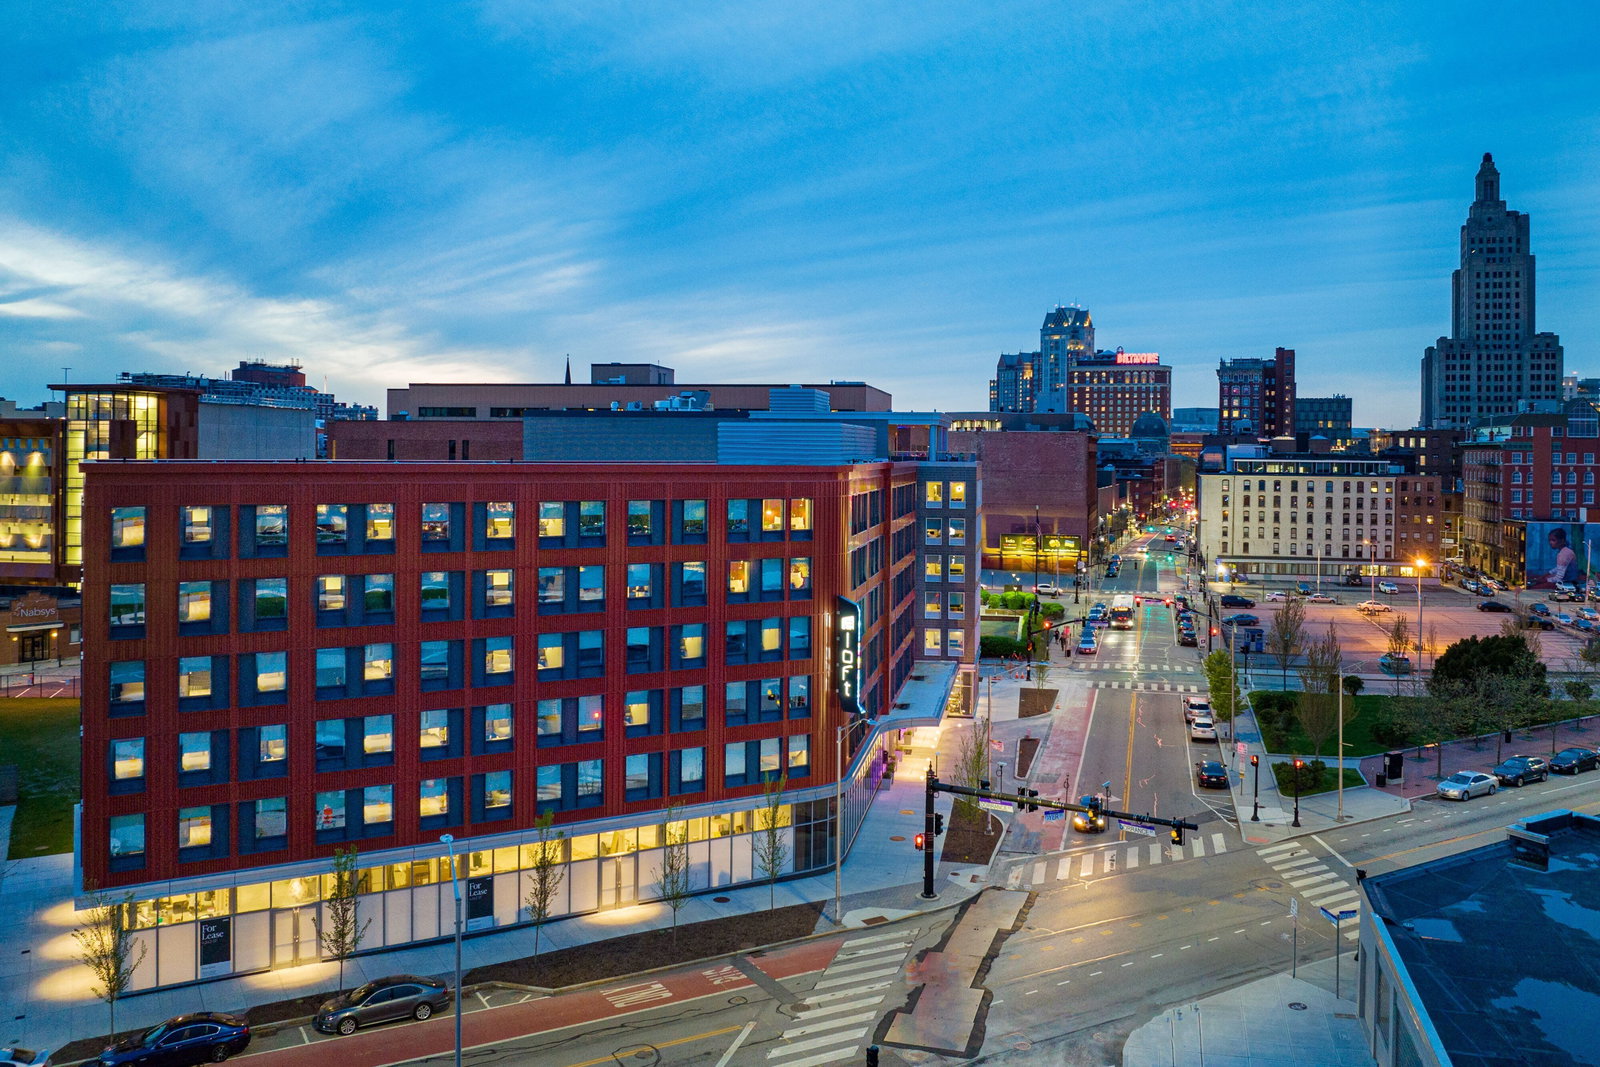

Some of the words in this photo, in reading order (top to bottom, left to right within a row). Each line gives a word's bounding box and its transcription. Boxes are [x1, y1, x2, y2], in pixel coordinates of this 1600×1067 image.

[20, 607, 56, 617] Nabsys
[469, 882, 482, 890] For
[202, 924, 217, 932] For
[202, 931, 224, 941] Lease
